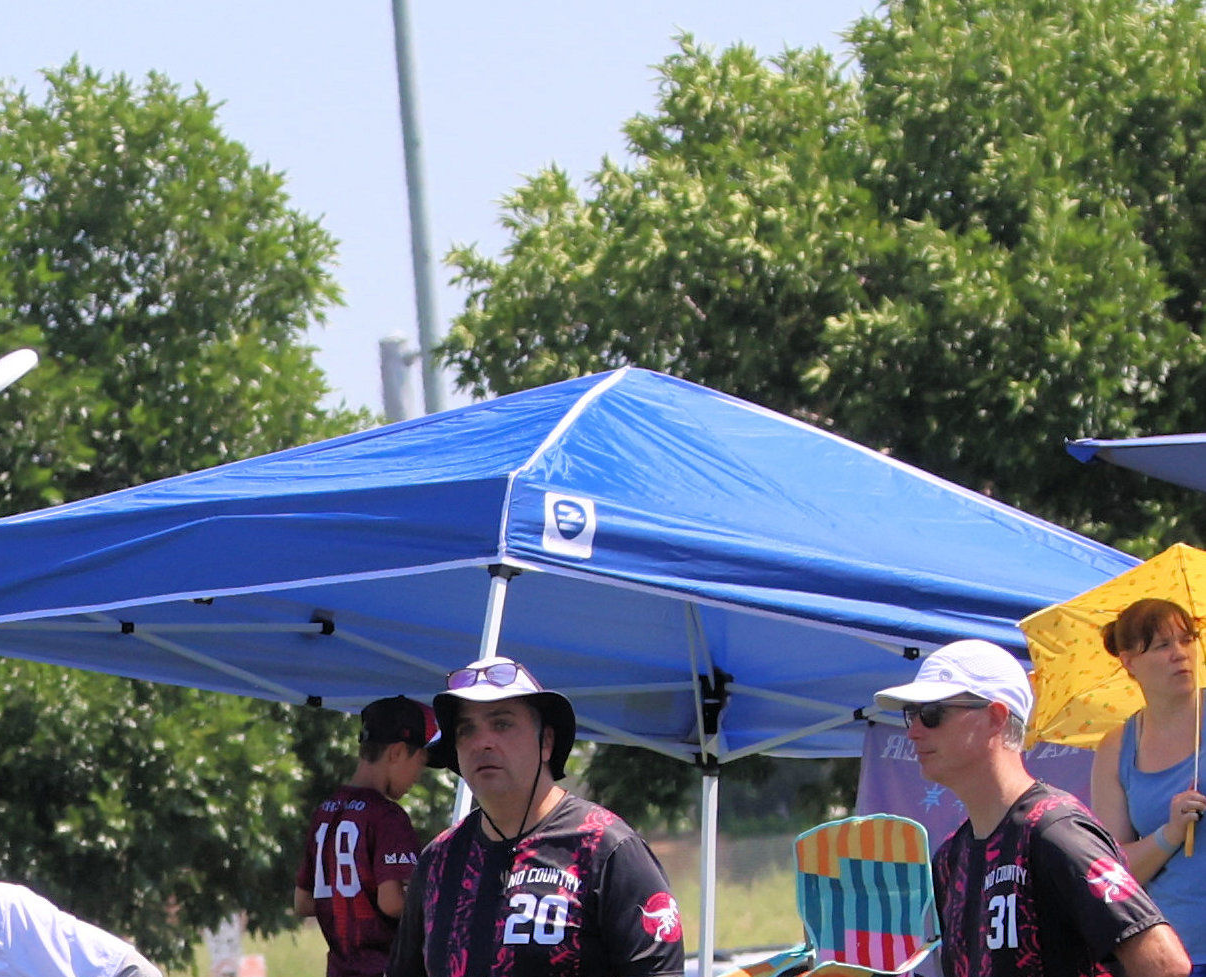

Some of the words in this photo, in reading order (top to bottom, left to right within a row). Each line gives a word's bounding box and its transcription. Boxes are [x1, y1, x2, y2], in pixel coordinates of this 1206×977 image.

[314, 820, 361, 898] 18
[507, 870, 526, 889] NO
[527, 867, 582, 893] COUNTRY
[503, 893, 569, 945] 20
[986, 893, 1019, 950] 31
